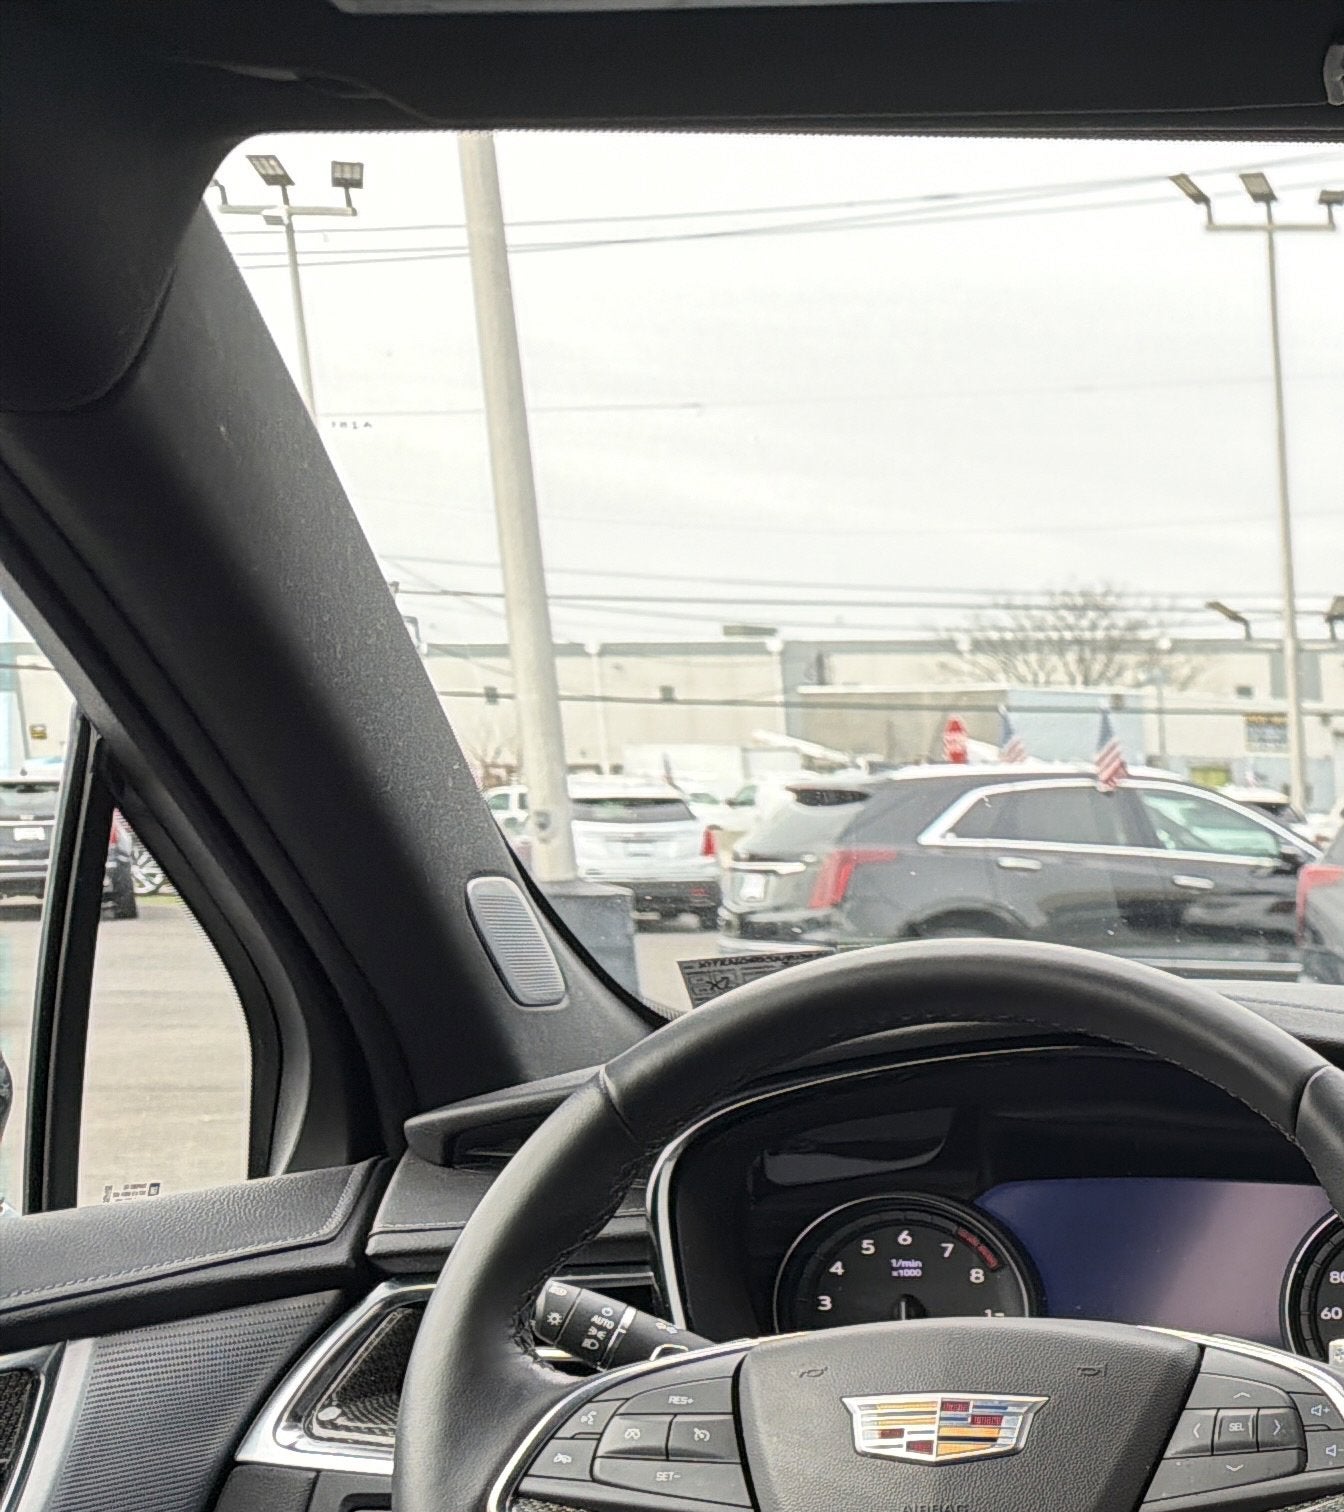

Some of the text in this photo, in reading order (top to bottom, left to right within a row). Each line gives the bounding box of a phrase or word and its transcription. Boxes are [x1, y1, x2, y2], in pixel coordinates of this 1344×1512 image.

[897, 1230, 912, 1245] 6
[861, 1239, 876, 1255] 5
[941, 1243, 954, 1258] 7
[829, 1261, 845, 1276] 4
[890, 1259, 922, 1269] 1/min
[969, 1268, 985, 1283] 8
[817, 1295, 832, 1311] 3
[1320, 1307, 1343, 1320] 60
[591, 1315, 615, 1330] AUTO
[668, 1395, 694, 1405] RES+
[1228, 1422, 1246, 1433] SEL
[656, 1471, 681, 1481] SET-
